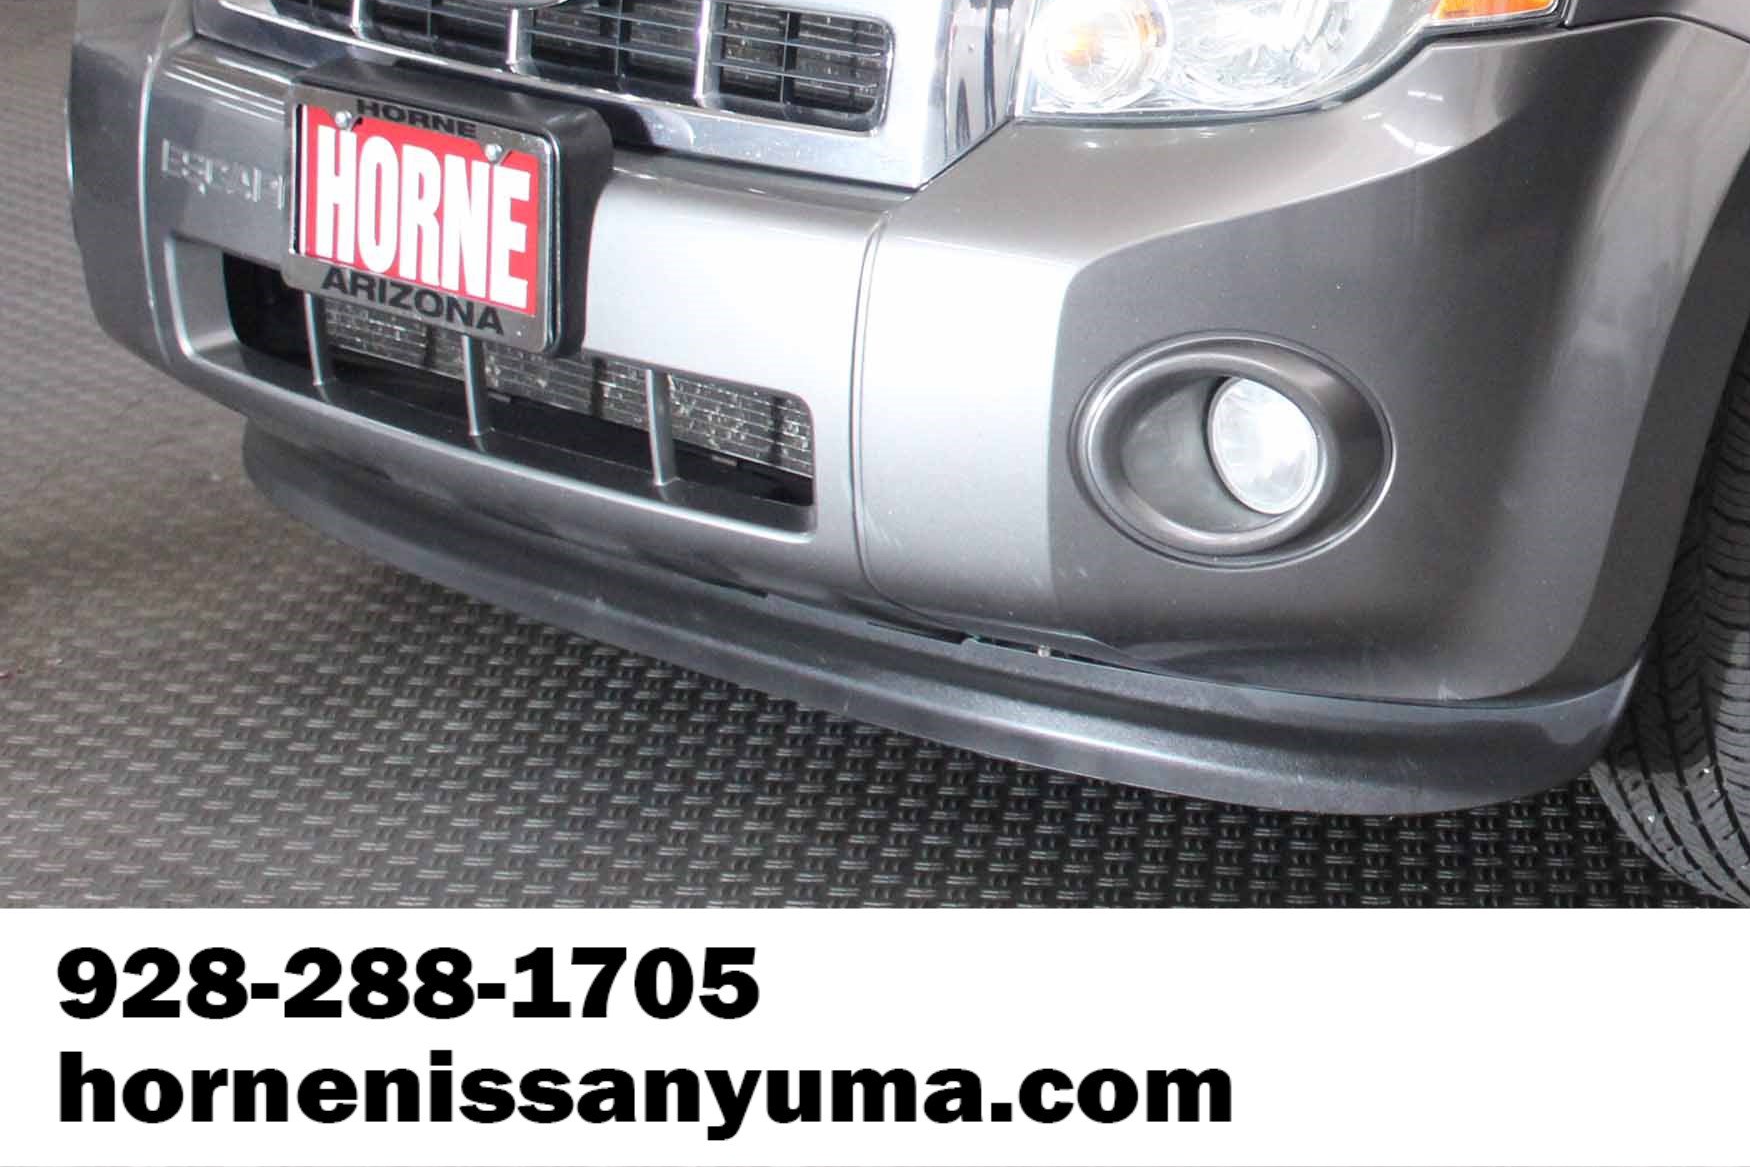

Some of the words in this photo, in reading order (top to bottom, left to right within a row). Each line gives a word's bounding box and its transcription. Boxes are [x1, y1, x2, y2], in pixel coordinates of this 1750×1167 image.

[355, 98, 478, 138] HORNE
[315, 124, 531, 309] HORNE
[320, 267, 504, 335] ARIZONA
